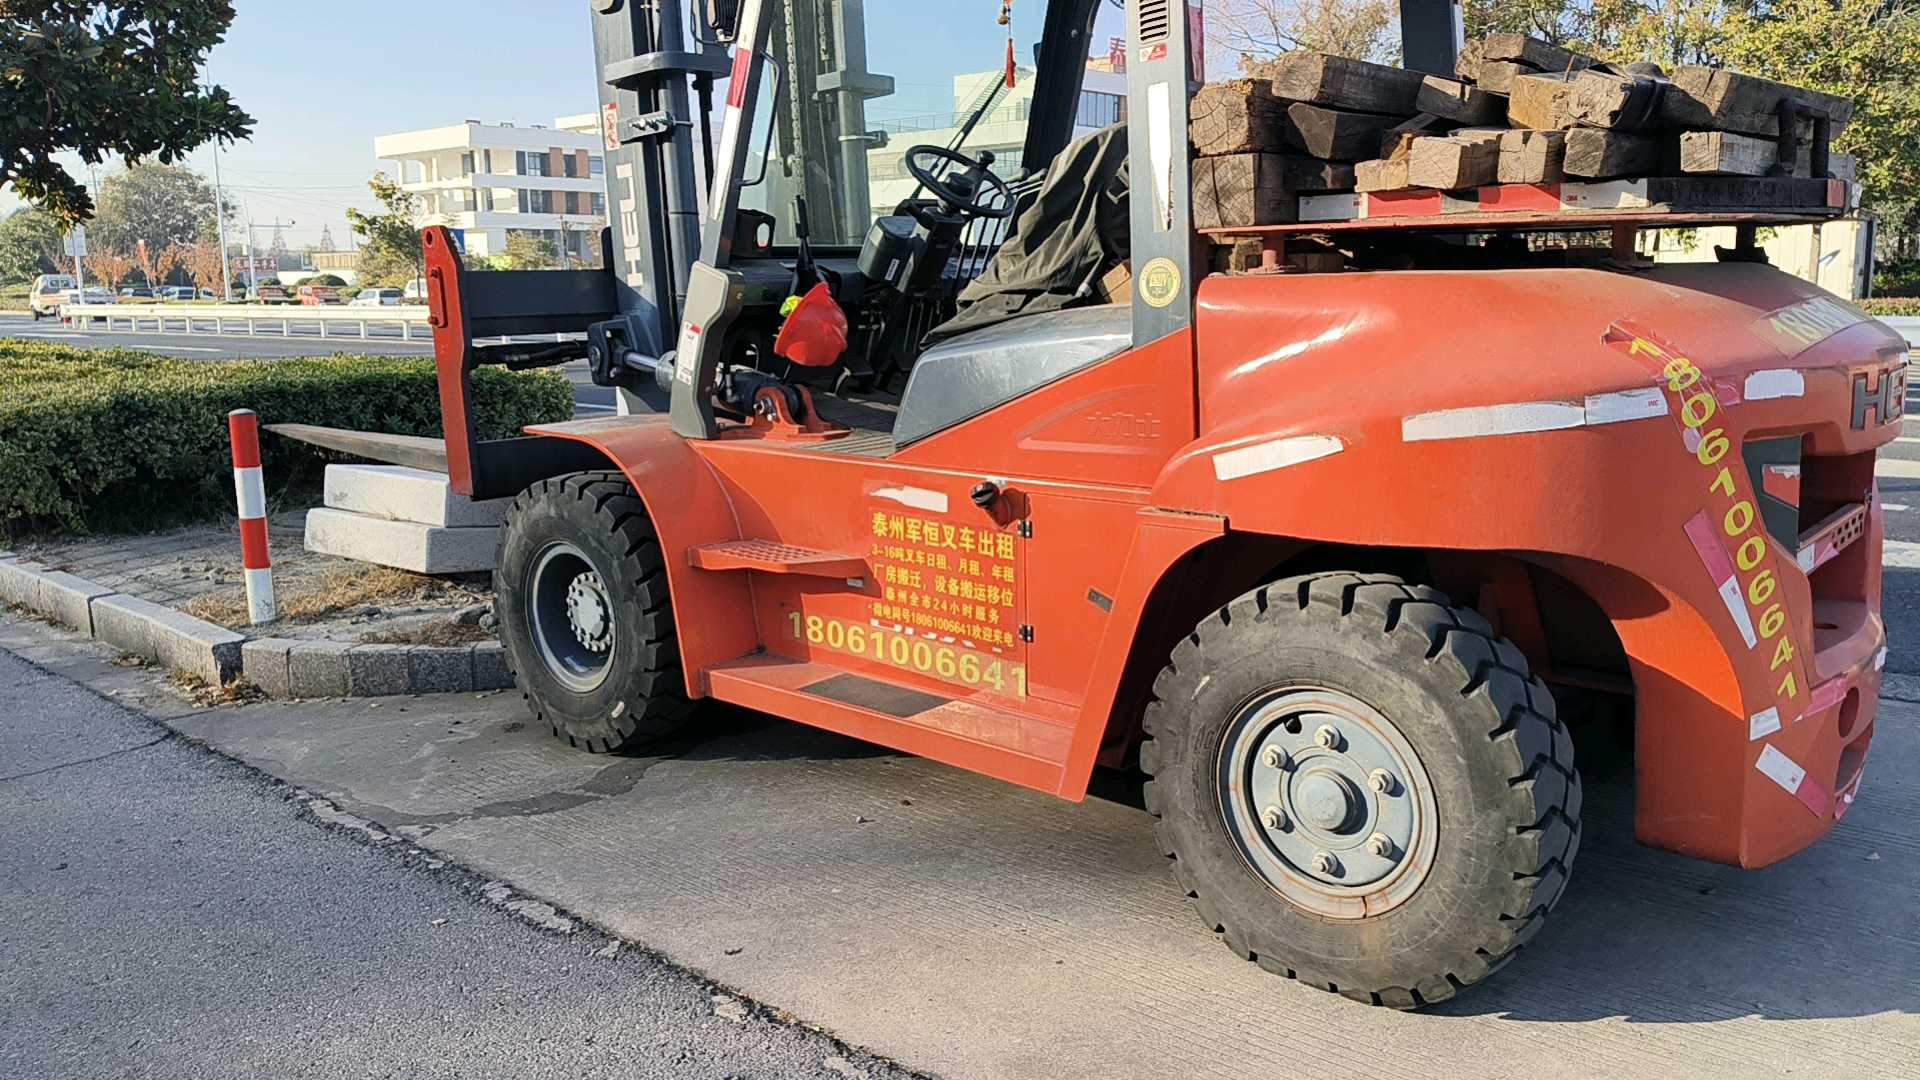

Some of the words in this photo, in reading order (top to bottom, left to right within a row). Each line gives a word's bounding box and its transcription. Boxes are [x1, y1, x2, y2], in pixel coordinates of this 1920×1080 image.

[615, 163, 644, 288] HELI
[871, 511, 1015, 561] 泰州军恒叉车出租
[1629, 336, 1801, 700] 18061006641
[885, 586, 1000, 625] 泰州全市24小时服务
[788, 611, 1027, 697] 18061006641
